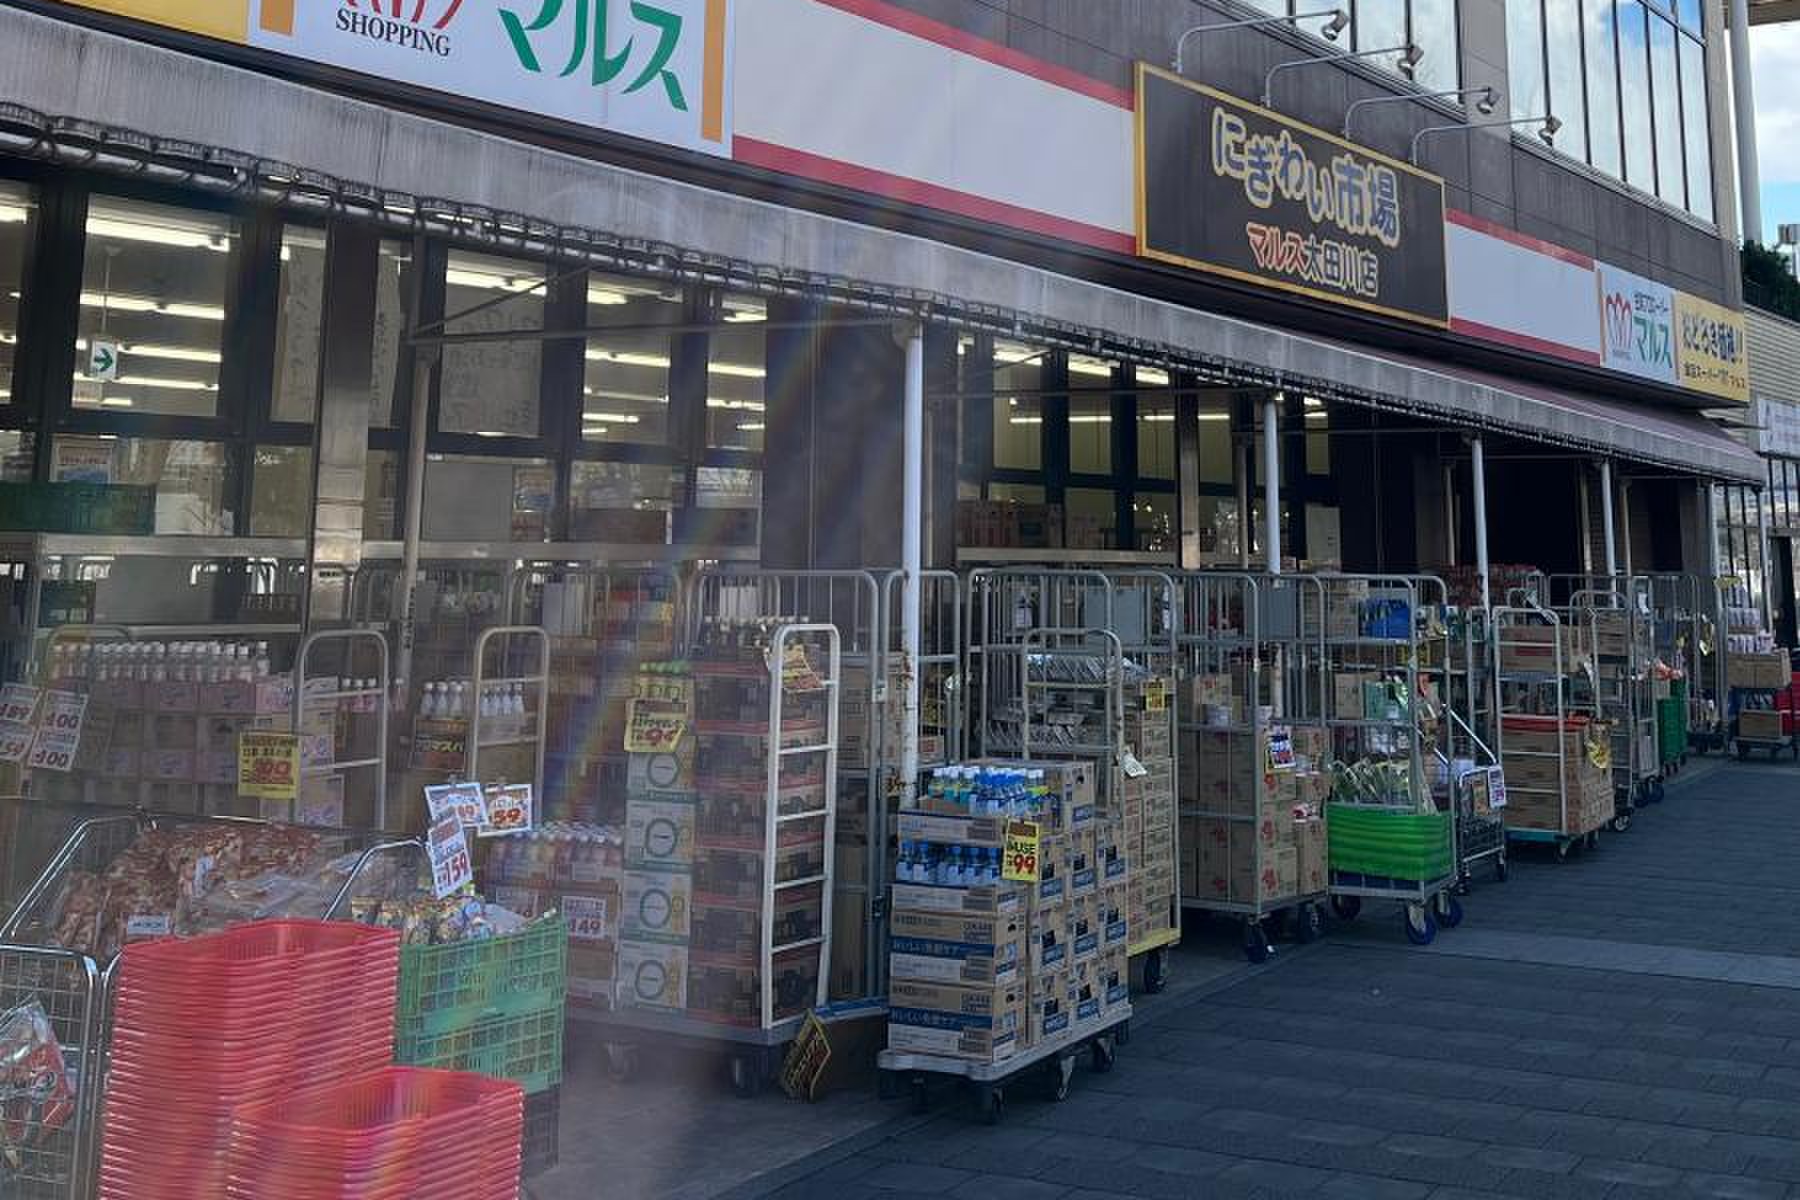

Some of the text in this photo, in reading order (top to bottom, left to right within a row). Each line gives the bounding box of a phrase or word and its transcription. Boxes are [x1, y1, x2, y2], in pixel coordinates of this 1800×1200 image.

[335, 7, 451, 57] SHOPPING
[1211, 105, 1400, 248] にぎわい市場
[1013, 853, 1036, 875] 99
